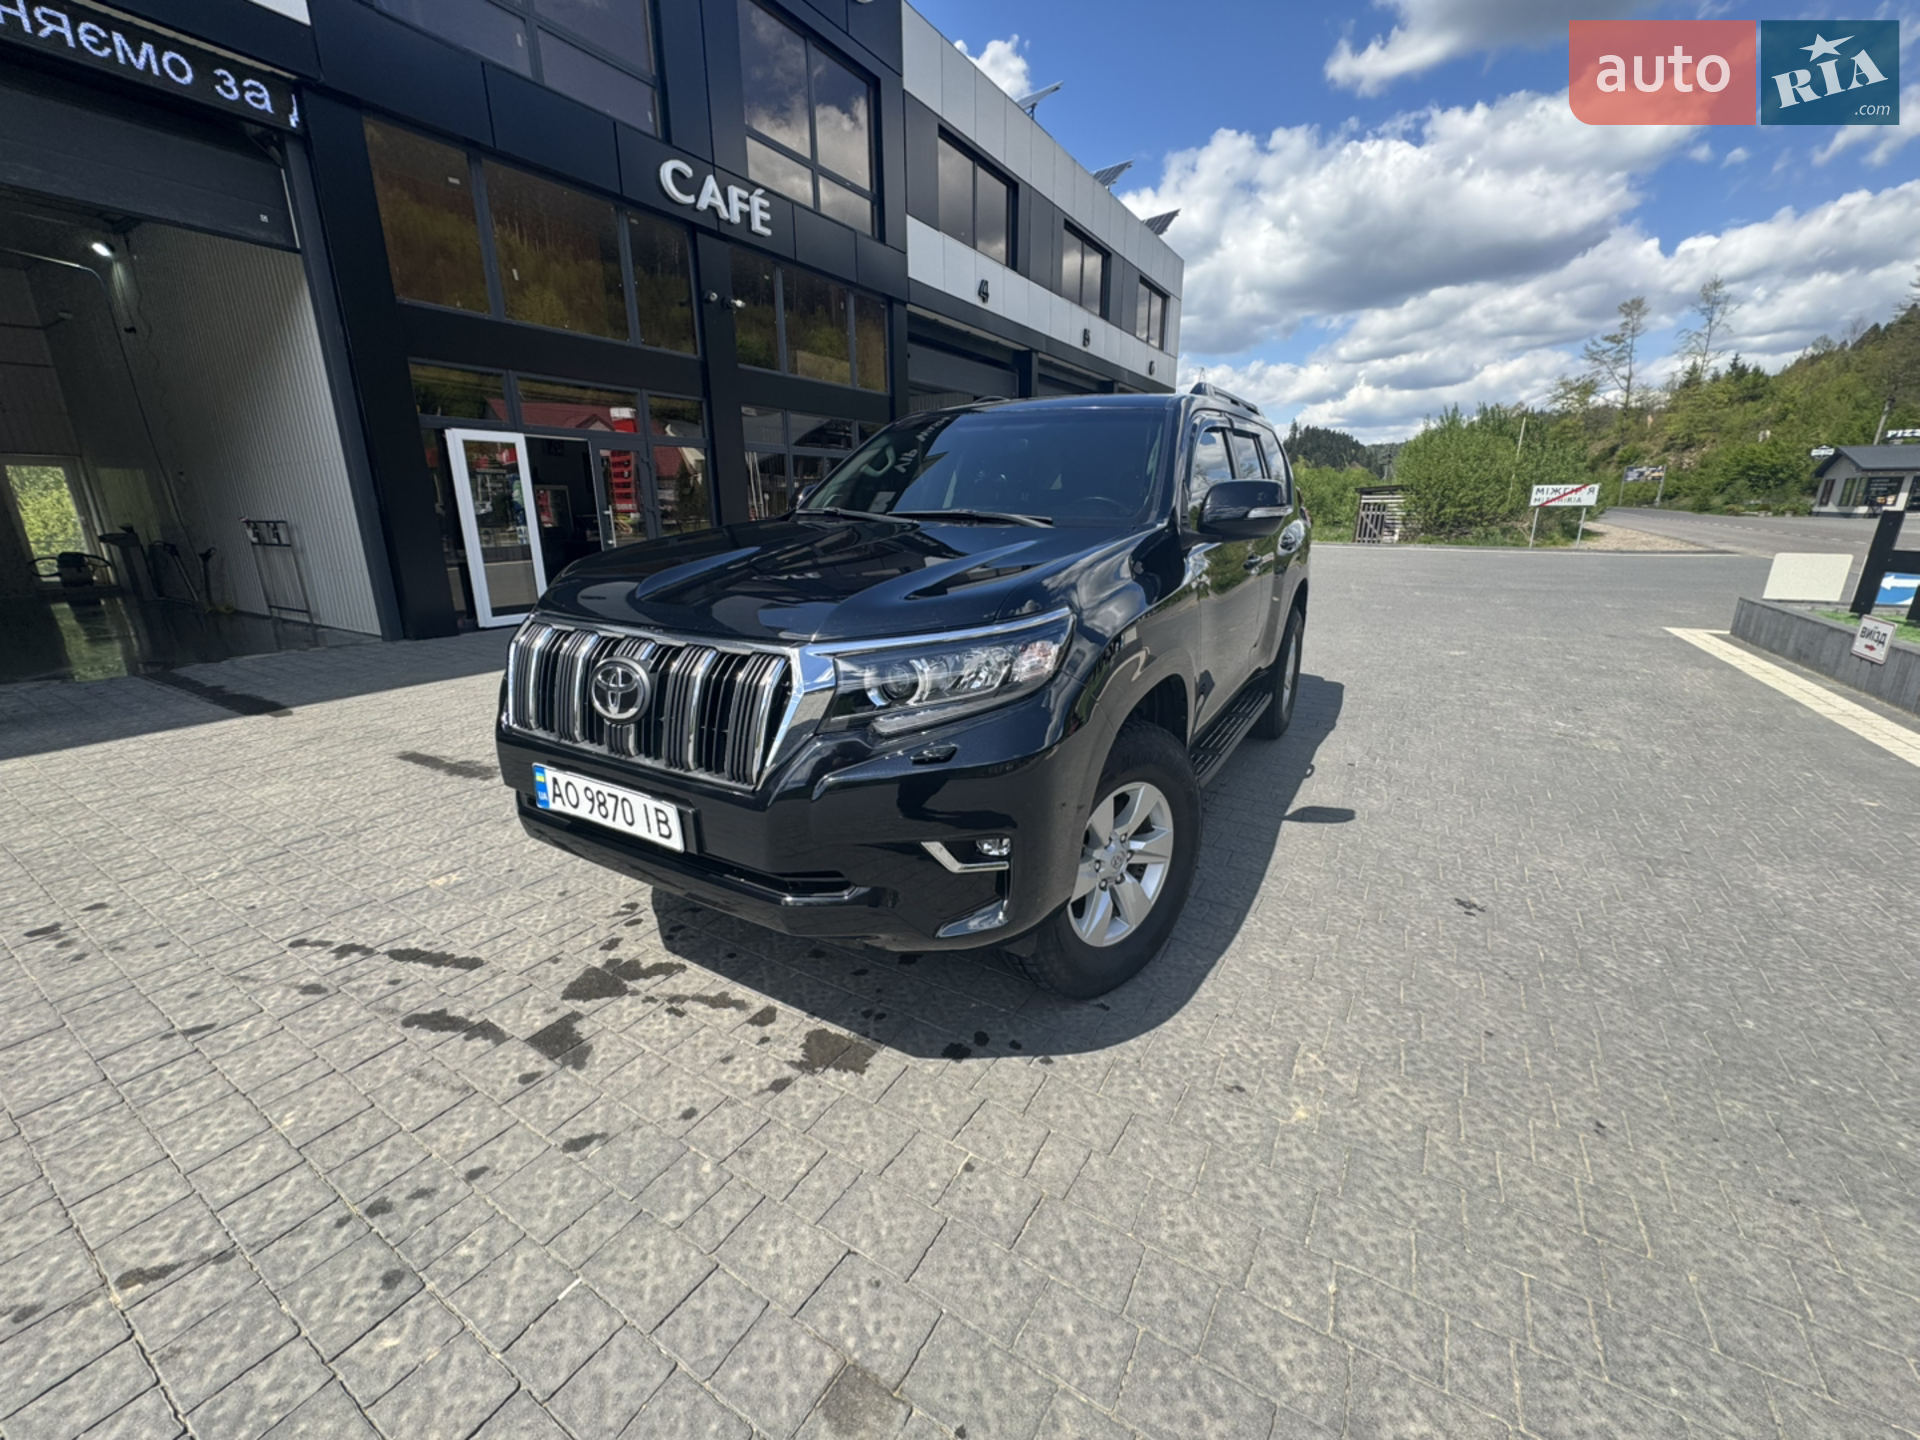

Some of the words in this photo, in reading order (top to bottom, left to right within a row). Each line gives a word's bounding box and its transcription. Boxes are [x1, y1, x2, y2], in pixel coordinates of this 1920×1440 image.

[213, 68, 275, 114] за
[660, 159, 772, 236] CAFÉ
[977, 279, 990, 304] 4
[552, 776, 580, 810] AO
[583, 786, 635, 828] 9870
[643, 803, 673, 840] IB
